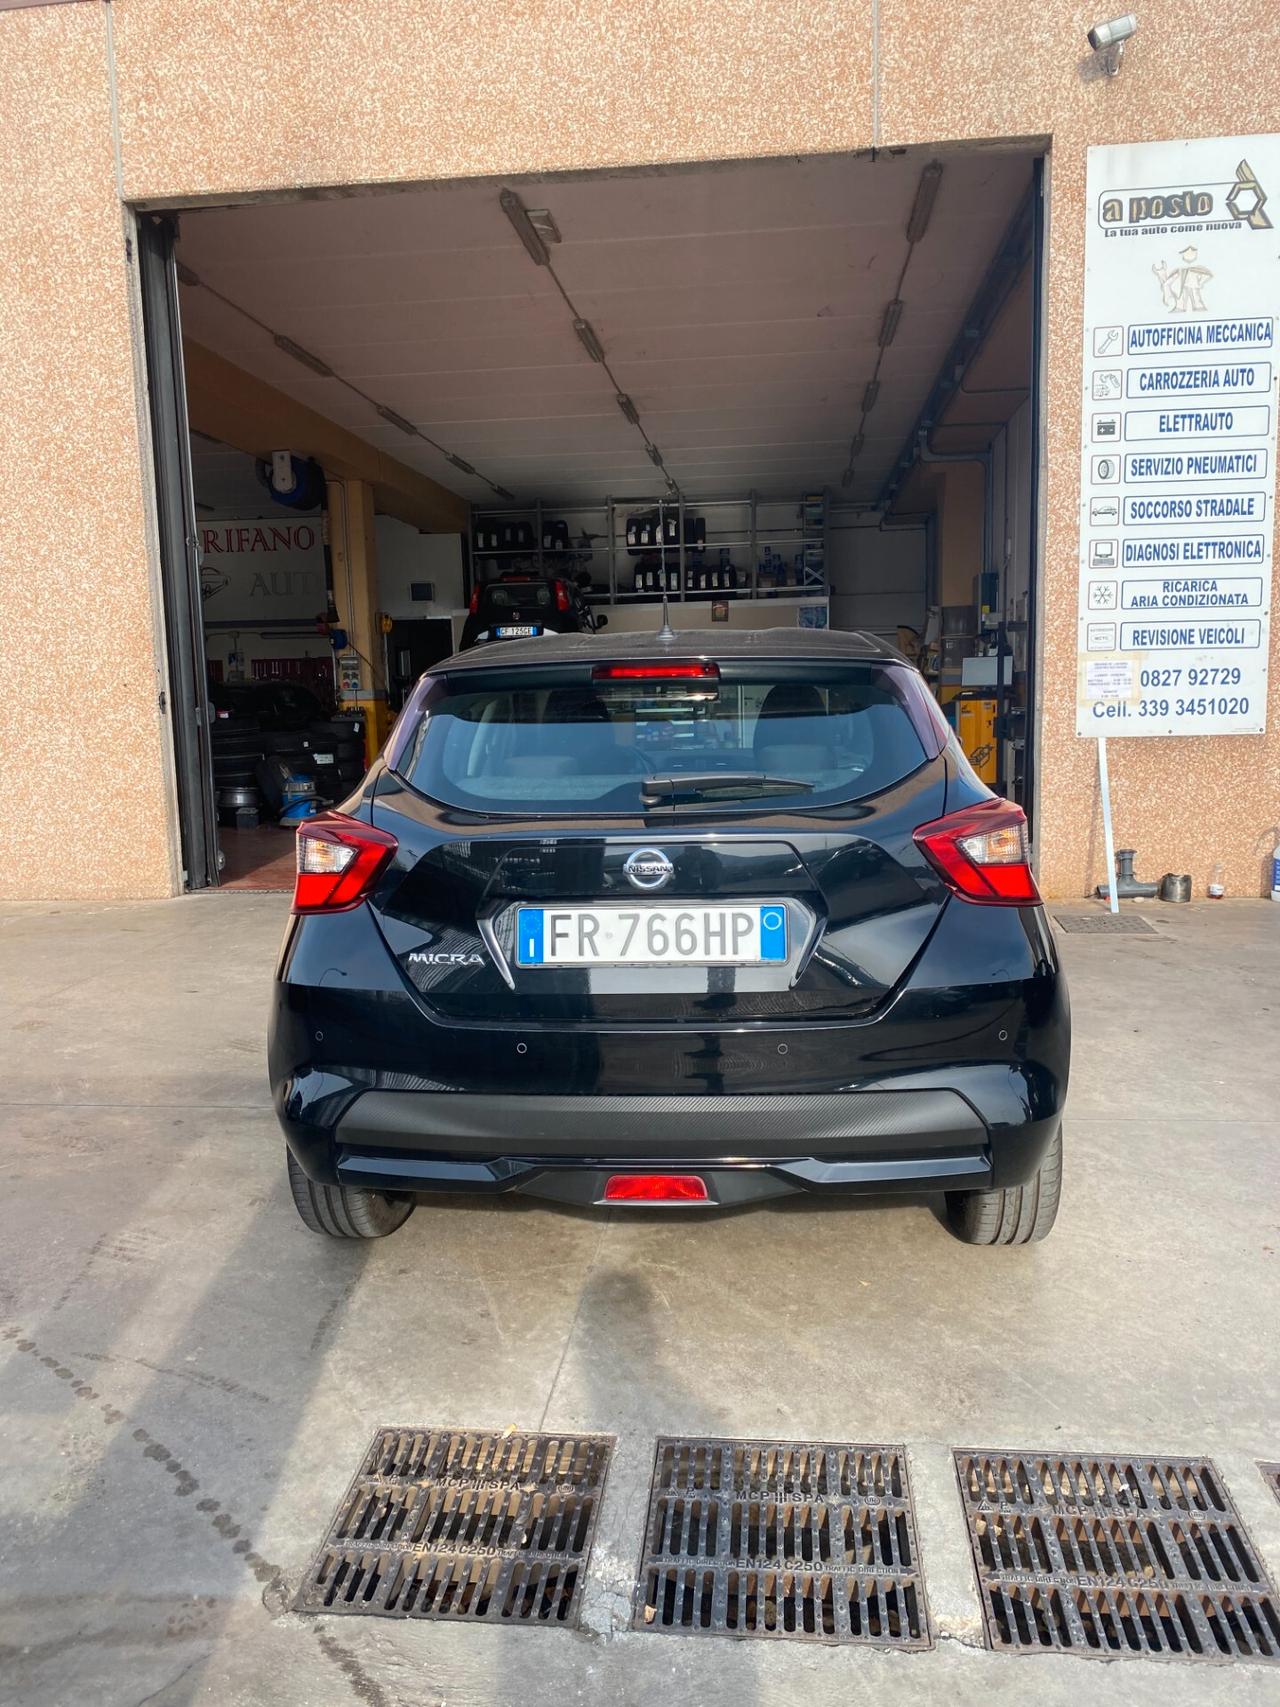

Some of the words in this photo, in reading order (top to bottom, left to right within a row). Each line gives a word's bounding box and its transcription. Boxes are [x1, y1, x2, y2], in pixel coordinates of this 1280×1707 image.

[1102, 199, 1123, 223] a
[1129, 190, 1213, 223] posto
[1105, 229, 1117, 238] La
[1120, 228, 1139, 237] tua
[1141, 225, 1168, 236] auto
[1170, 224, 1202, 234] come
[1206, 221, 1242, 231] nuova
[1130, 326, 1203, 348] AUTOFFICINA
[1206, 322, 1272, 344] MECCANICA
[1140, 369, 1220, 391] CARROZZERIA
[1223, 368, 1255, 387] AUTO
[1159, 412, 1233, 433] ELETTRAUTO
[1131, 457, 1183, 476] SERVIZIO
[1187, 454, 1257, 474] PNEUMATICI
[1131, 500, 1192, 519] SOCCORSO
[1196, 498, 1255, 517] STRADALE
[1126, 542, 1180, 562] DIAGNOSI
[1183, 540, 1261, 560] ELETTRONICA
[250, 571, 320, 597] AUT
[1163, 580, 1218, 593] RICARICA
[1131, 595, 1158, 607] ARIA
[1162, 593, 1249, 606] CONDIZIONATA
[1133, 629, 1195, 646] REVISIONE
[1199, 627, 1245, 645] VEICOLI
[1140, 669, 1182, 687] 0827
[1188, 667, 1241, 686] 92729
[1092, 701, 1132, 718] Cell.
[1138, 699, 1169, 717] 339
[1175, 697, 1249, 715] 3451020
[628, 864, 672, 873] NISSAN
[549, 913, 600, 957] FR
[618, 912, 754, 957] 766HP
[408, 953, 486, 968] MICRA
[736, 1490, 770, 1501] MCP
[792, 1492, 824, 1504] SPA
[736, 1558, 782, 1570] EN124
[785, 1561, 822, 1572] C250
